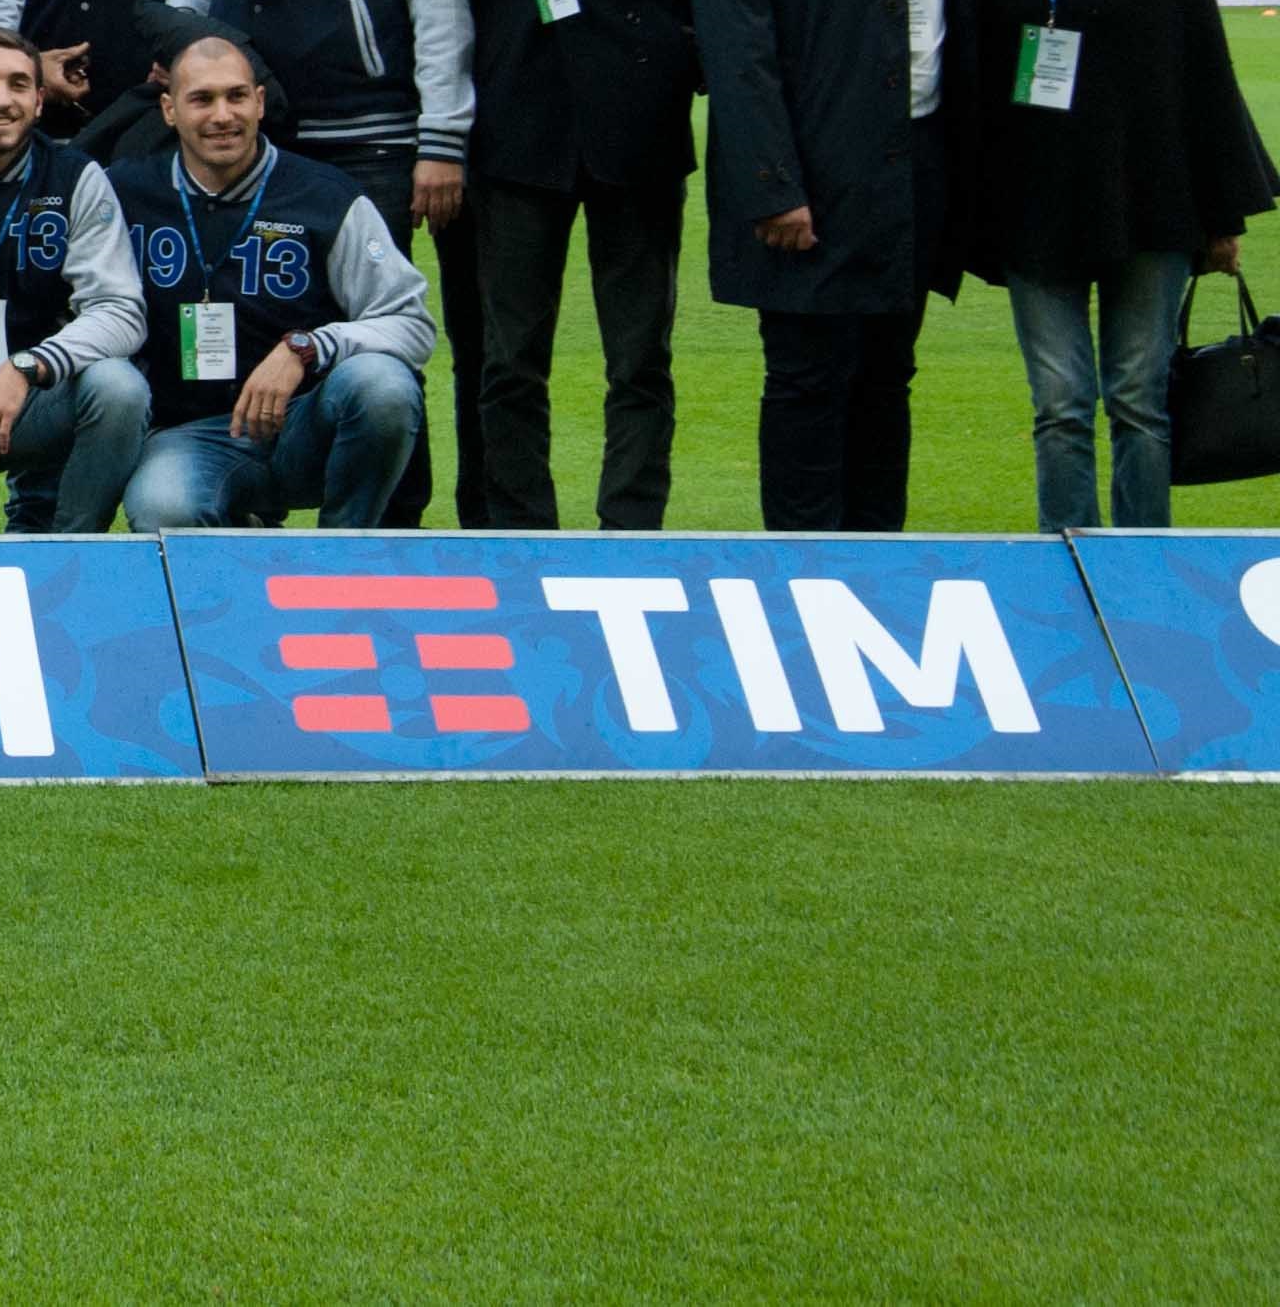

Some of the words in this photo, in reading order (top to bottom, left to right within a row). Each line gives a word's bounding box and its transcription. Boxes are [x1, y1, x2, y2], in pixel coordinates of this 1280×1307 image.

[8, 210, 70, 272] 13
[131, 223, 188, 289] 19
[233, 236, 311, 299] 13
[541, 576, 1042, 734] TIM
